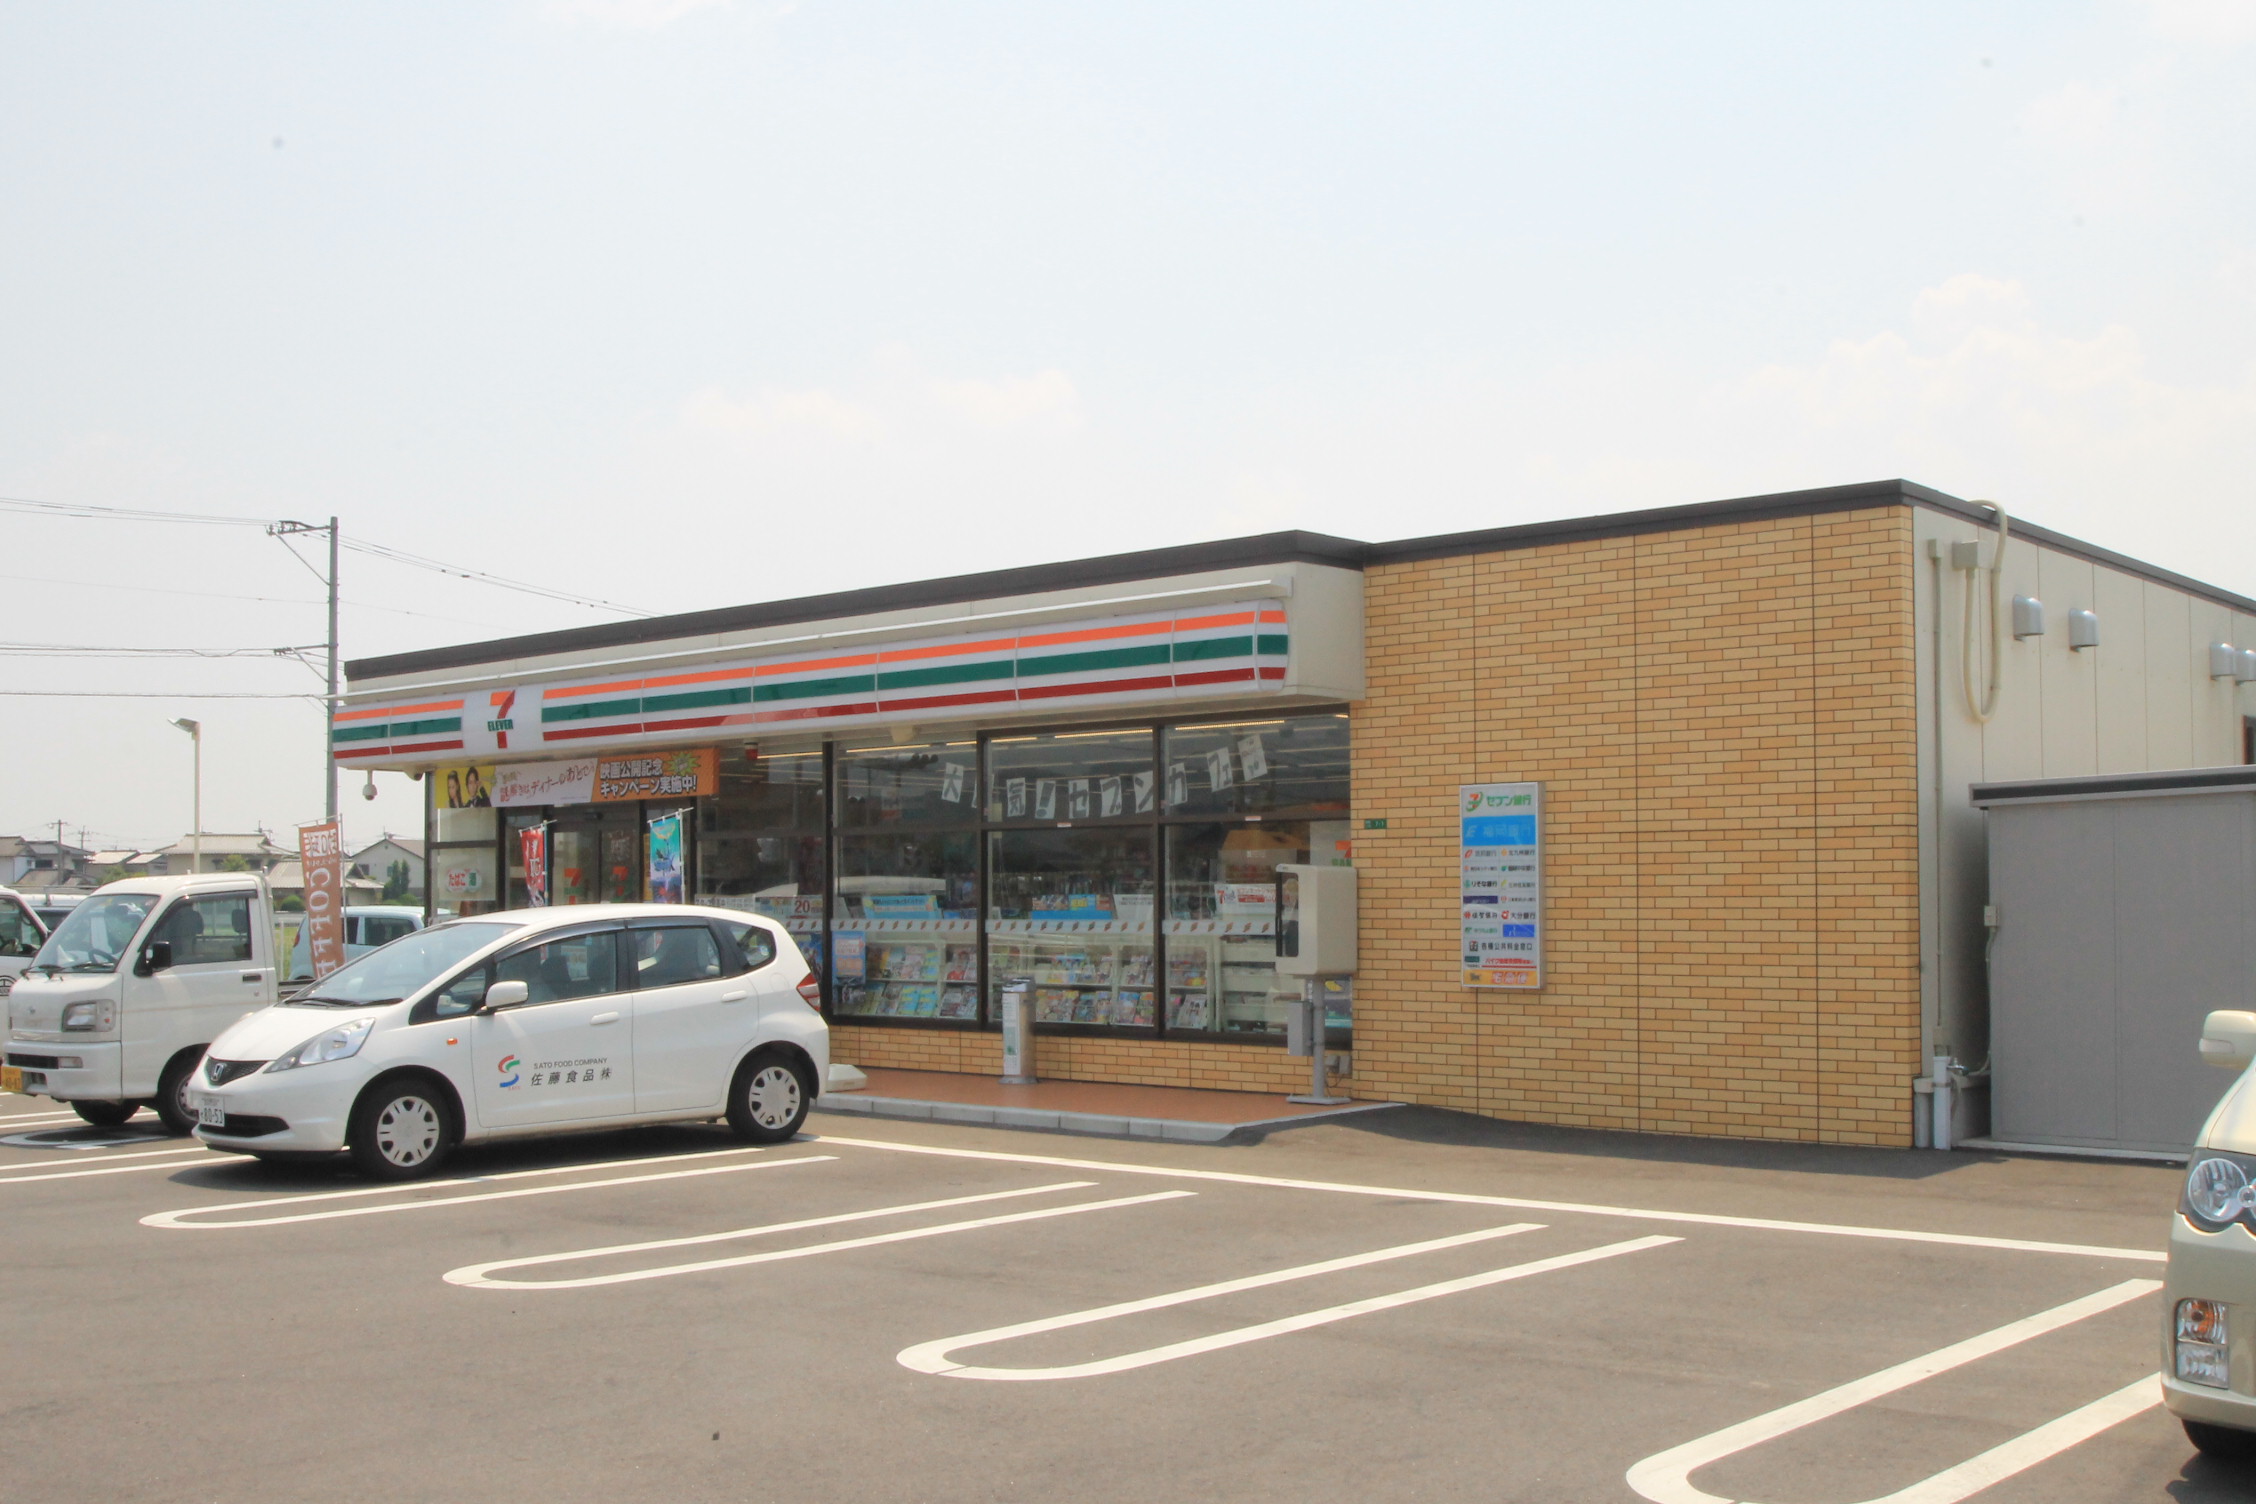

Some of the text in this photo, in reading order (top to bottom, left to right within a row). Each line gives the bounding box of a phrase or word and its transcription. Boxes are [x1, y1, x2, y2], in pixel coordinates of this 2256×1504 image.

[490, 689, 515, 749] 7
[600, 758, 663, 779] 映画公開記念
[1487, 794, 1532, 807] セブン銀行
[1472, 880, 1498, 888] りそな銀行
[794, 899, 811, 914] 20
[1482, 942, 1533, 951] 各種公共料金窓口
[534, 1057, 608, 1070] SATO FOOD COMPANY
